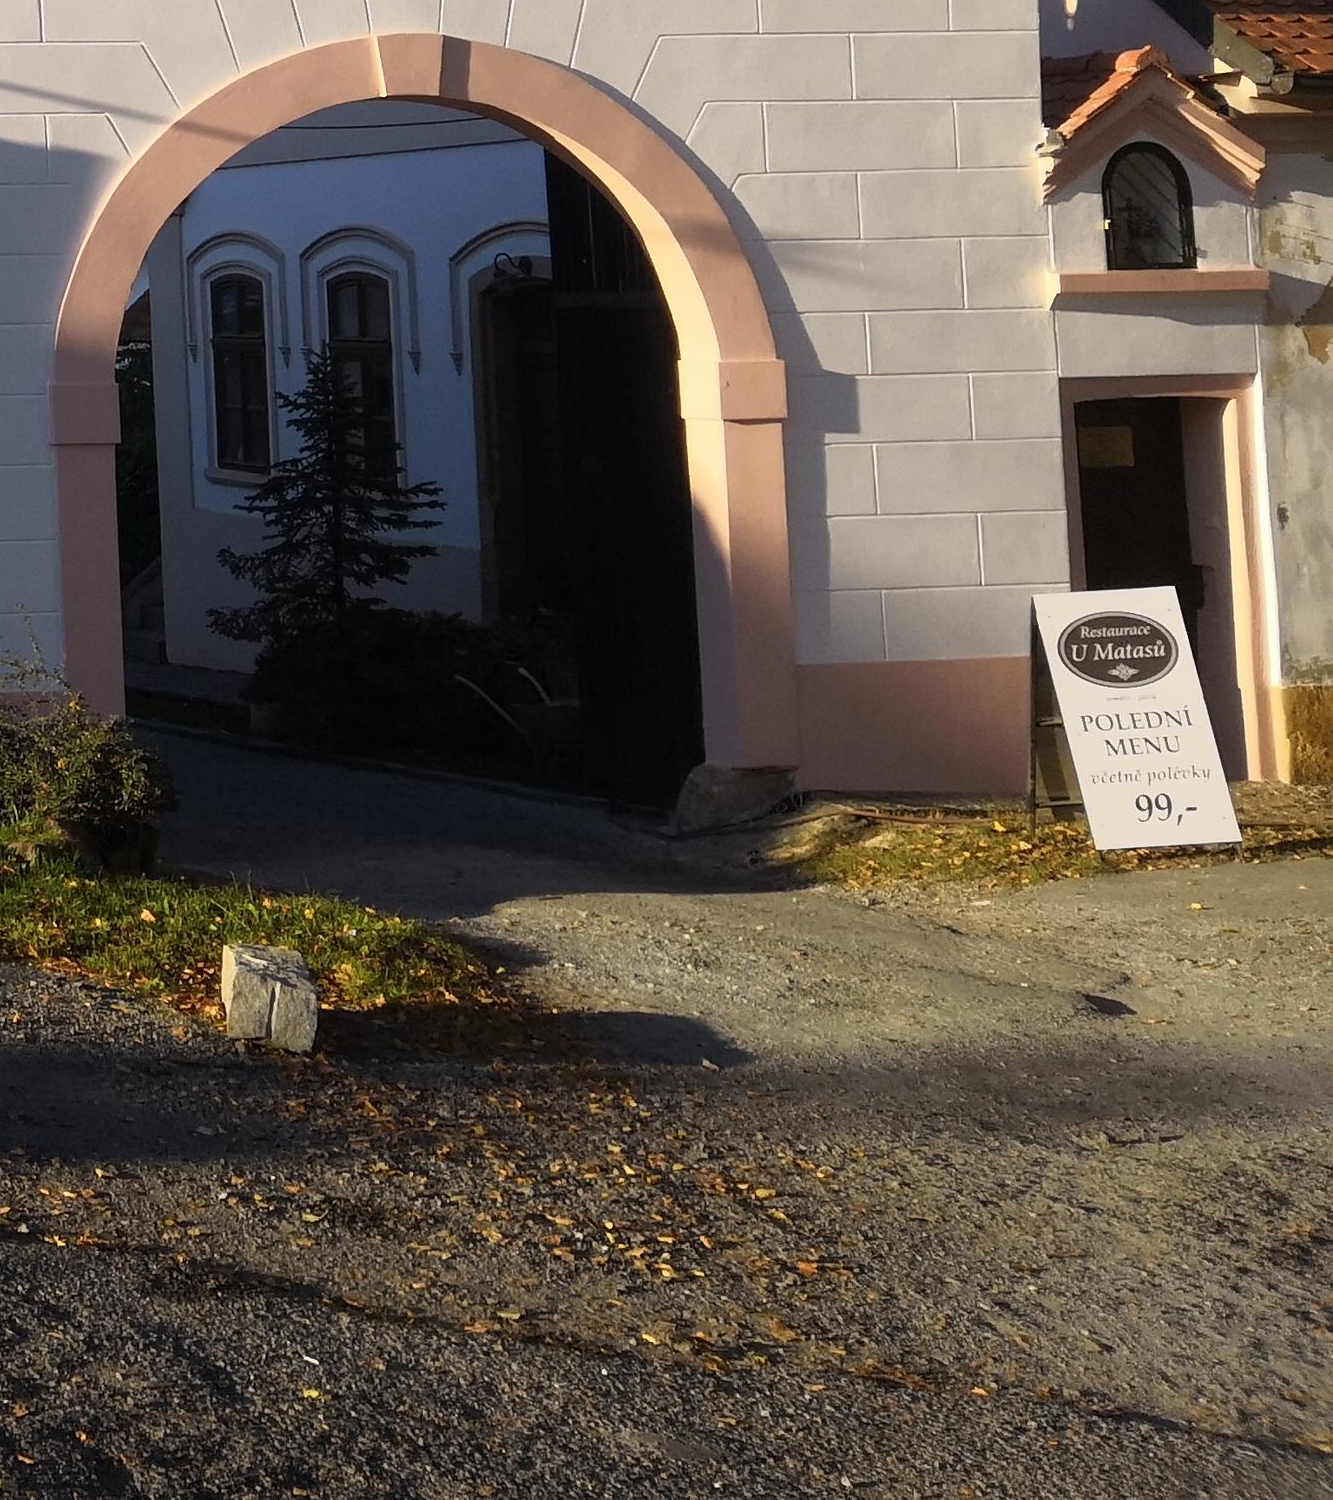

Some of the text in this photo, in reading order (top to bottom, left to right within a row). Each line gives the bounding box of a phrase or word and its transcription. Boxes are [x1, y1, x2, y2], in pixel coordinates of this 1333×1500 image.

[1080, 625, 1151, 639] Restaurace
[1071, 639, 1166, 662] U Matasů
[1080, 704, 1193, 733] POLEDNÍ
[1104, 735, 1181, 757] MENU
[1090, 764, 1212, 786] včetně polévky
[1134, 792, 1198, 826] 99,-
